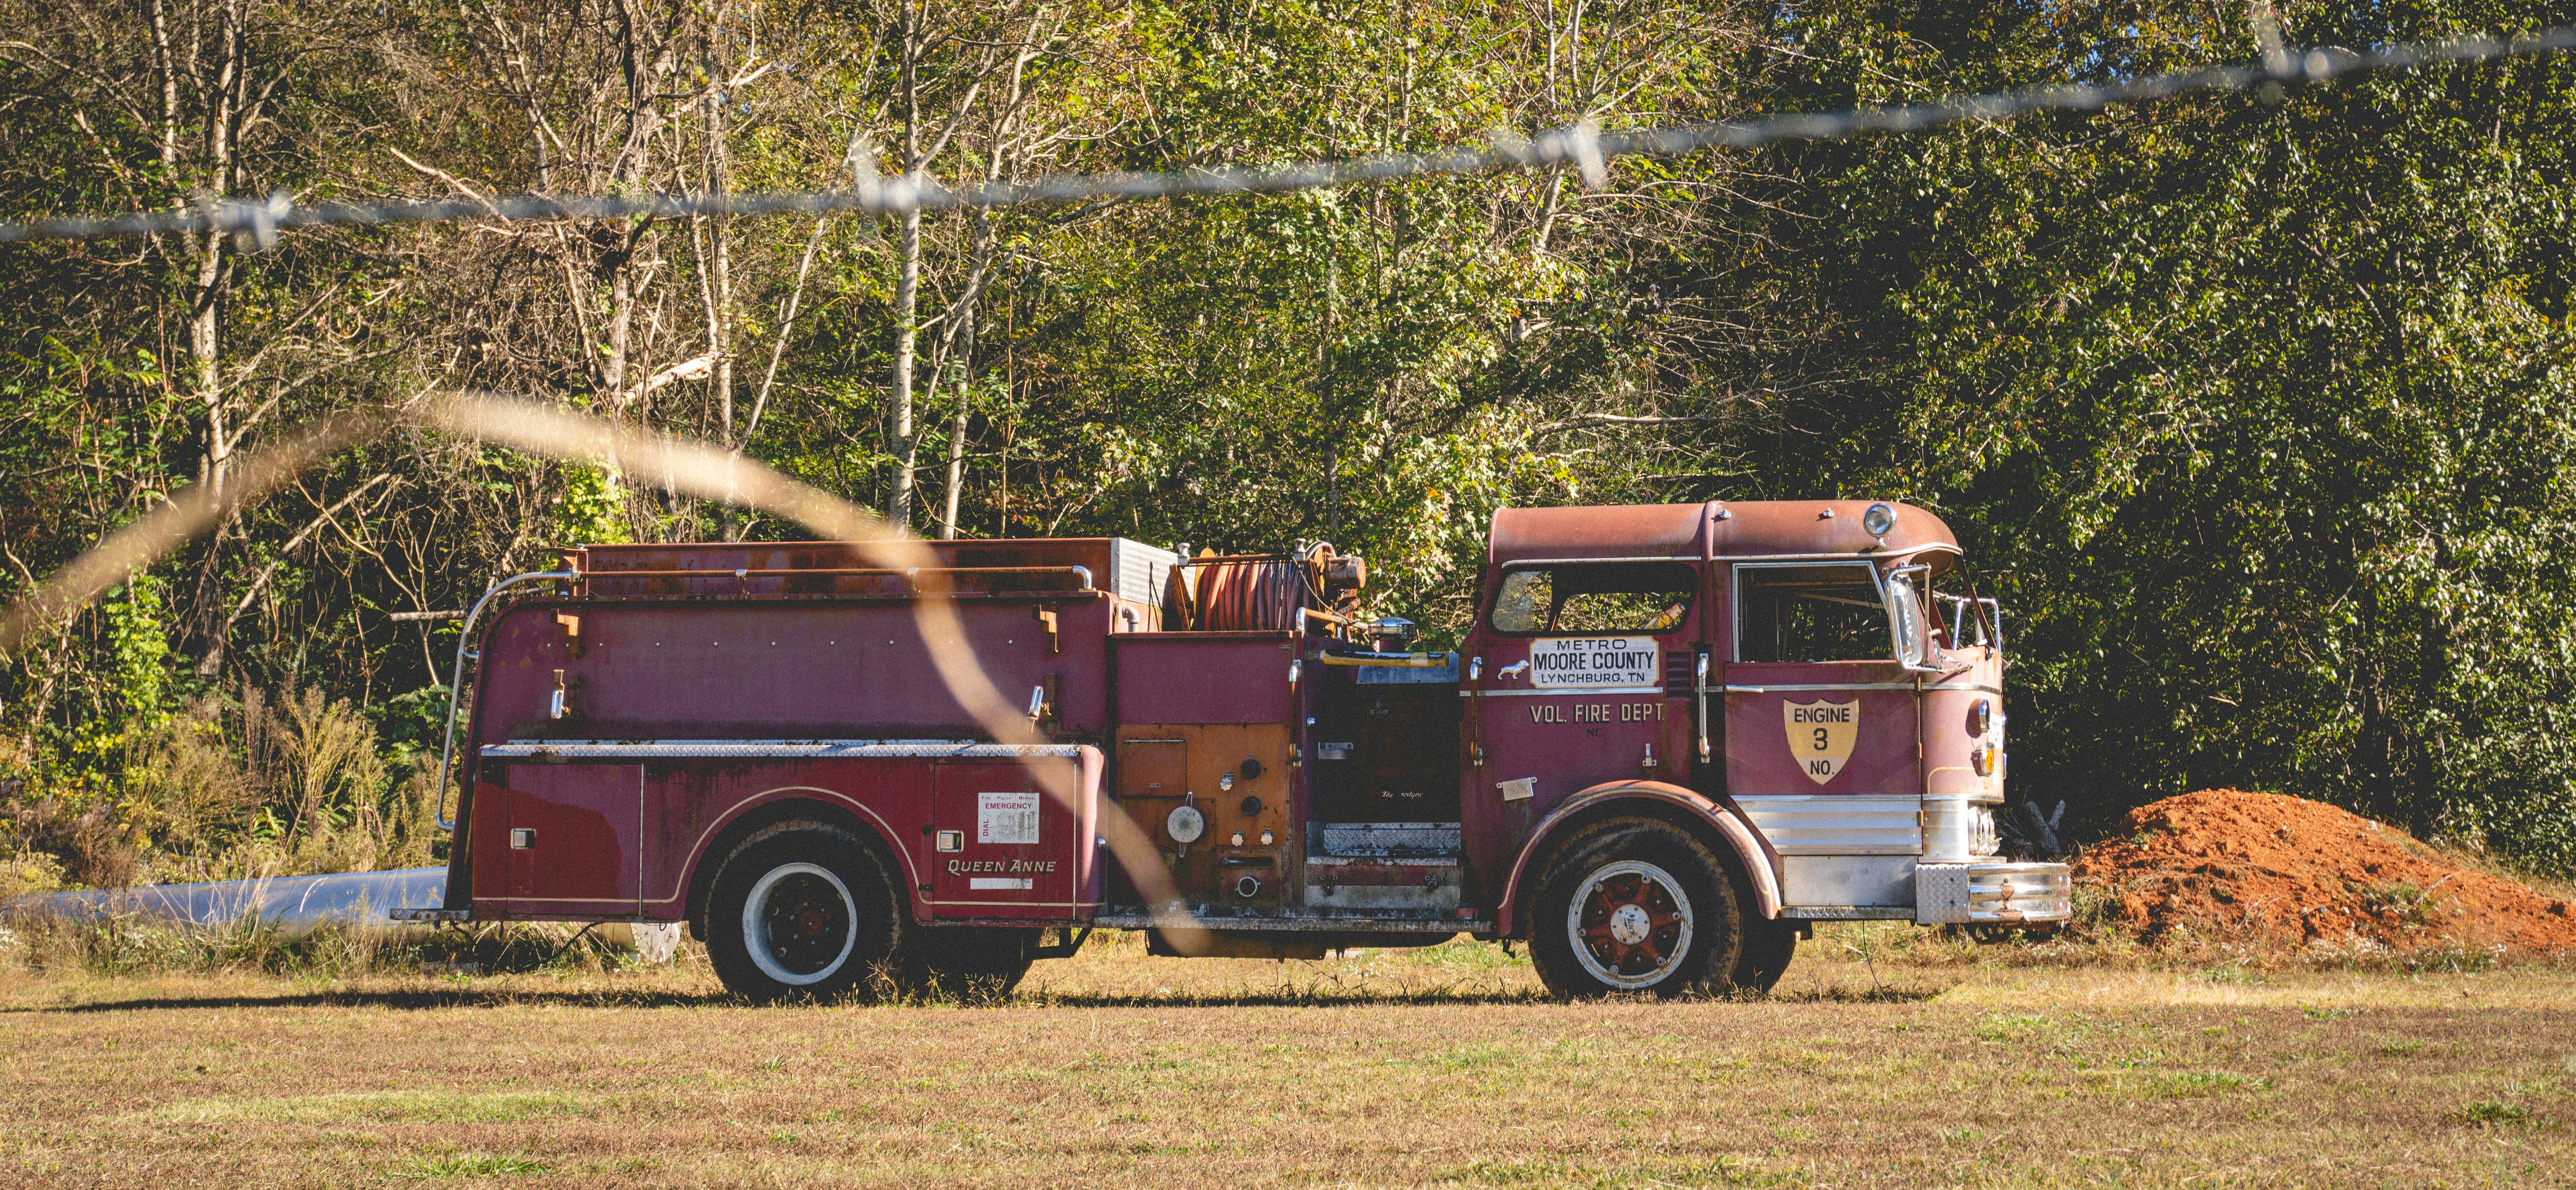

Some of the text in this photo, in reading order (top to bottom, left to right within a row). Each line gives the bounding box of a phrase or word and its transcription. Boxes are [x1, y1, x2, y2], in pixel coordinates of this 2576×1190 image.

[1557, 639, 1627, 650] METRO
[1534, 652, 1654, 670] MOORE COUNTY
[1542, 673, 1645, 683] LYNCHBURG, TN
[1530, 705, 1567, 724] VOL.
[1574, 704, 1610, 723] FIRE
[1795, 708, 1850, 723] ENGINE
[1814, 728, 1828, 750] 3
[1810, 760, 1834, 775] NO.
[947, 859, 1056, 876] QUEEN ANNE
